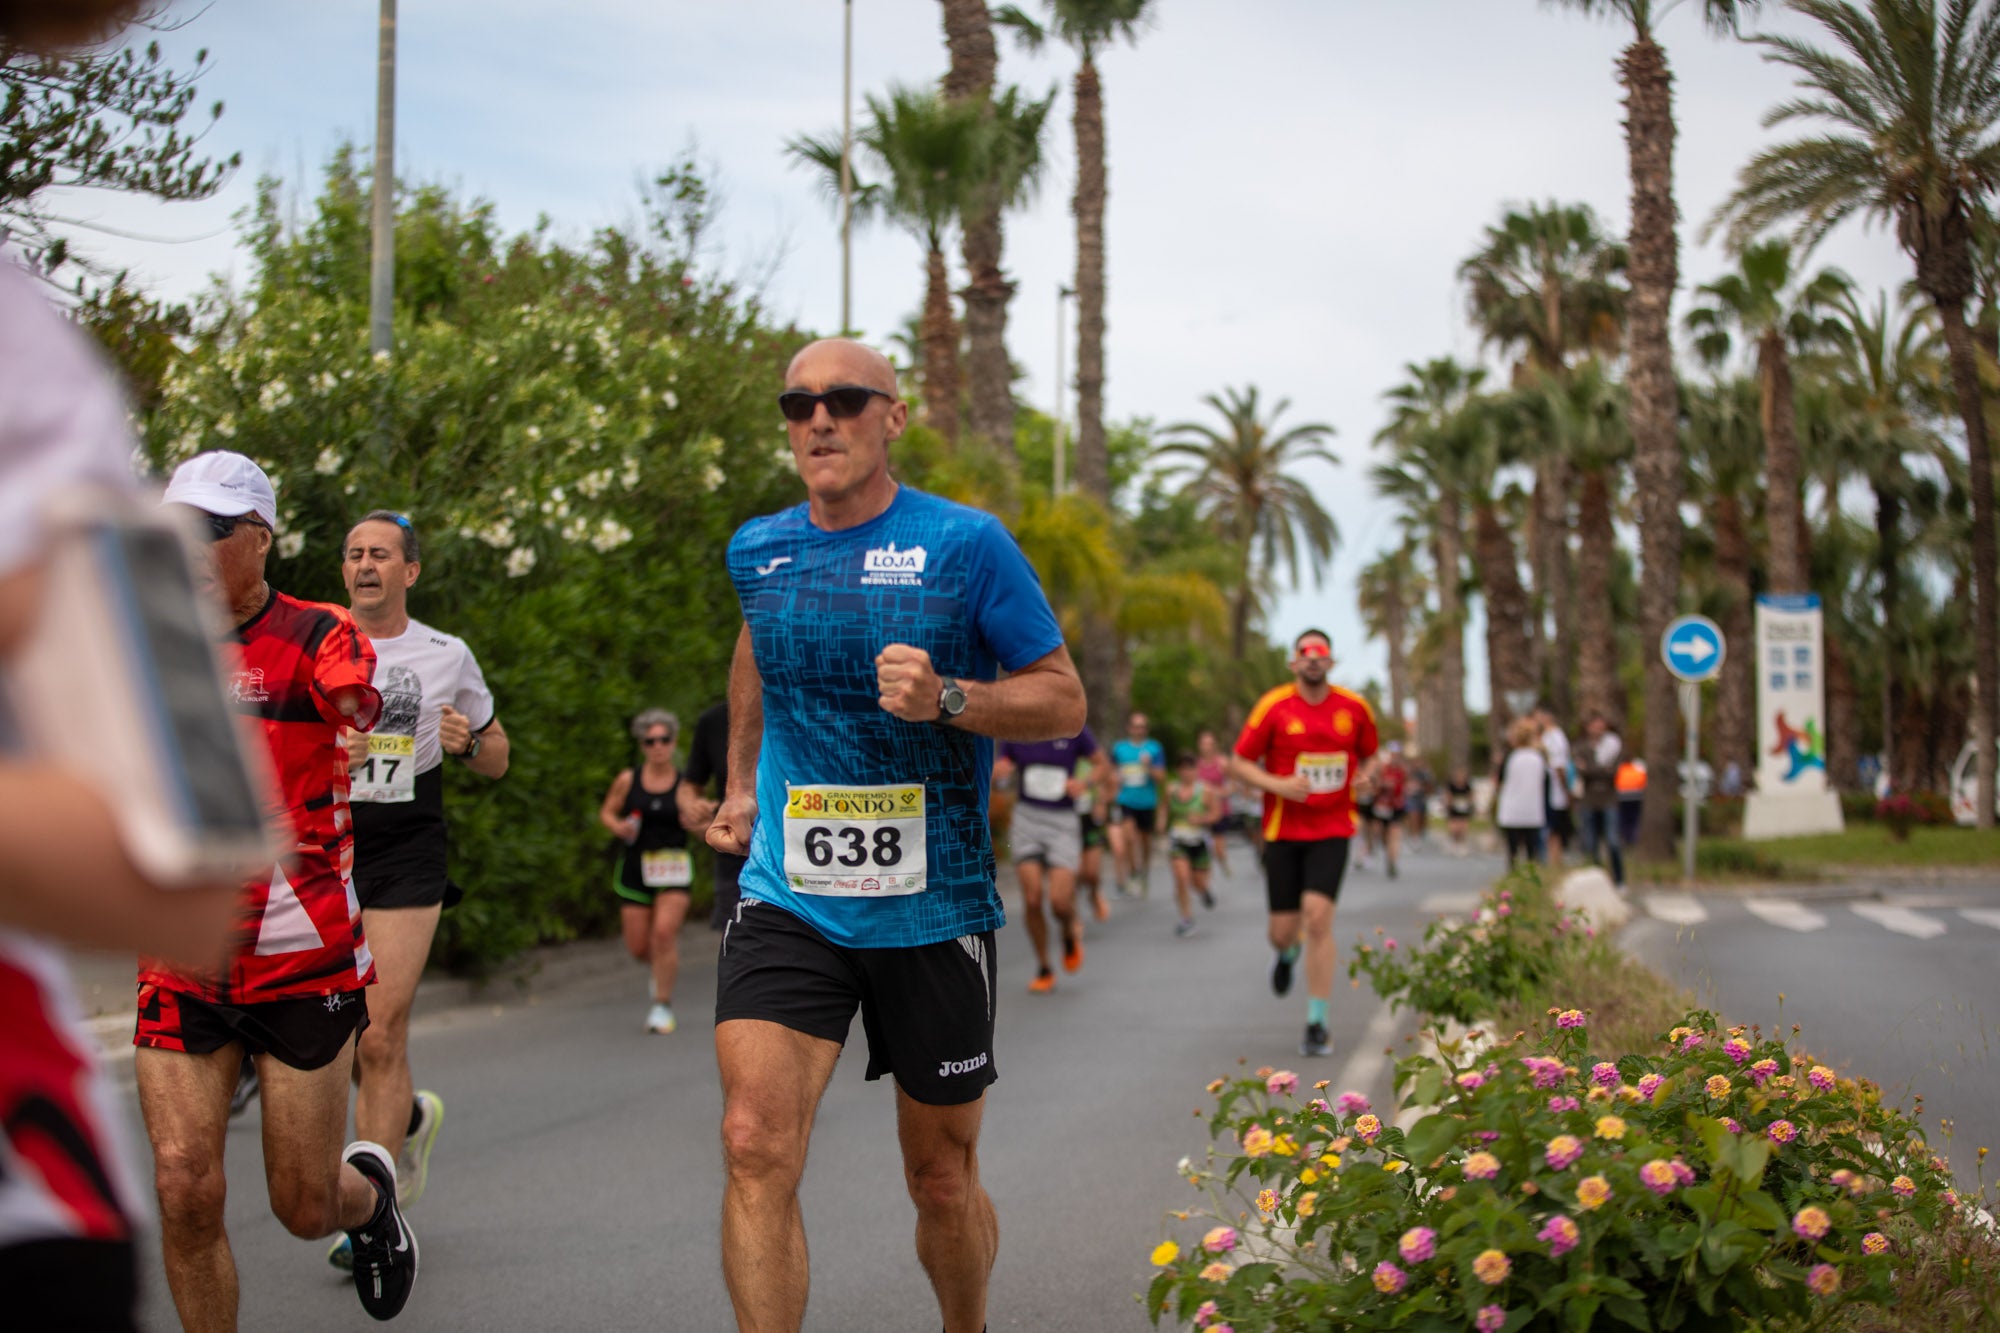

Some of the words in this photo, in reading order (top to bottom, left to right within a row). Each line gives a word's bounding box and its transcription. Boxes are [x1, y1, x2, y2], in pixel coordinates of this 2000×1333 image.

[873, 556, 916, 568] LOJA
[802, 793, 823, 811] 38
[827, 792, 851, 800] GRAN
[823, 799, 894, 813] FONDO
[805, 826, 902, 867] 638
[938, 1052, 987, 1077] Joma
